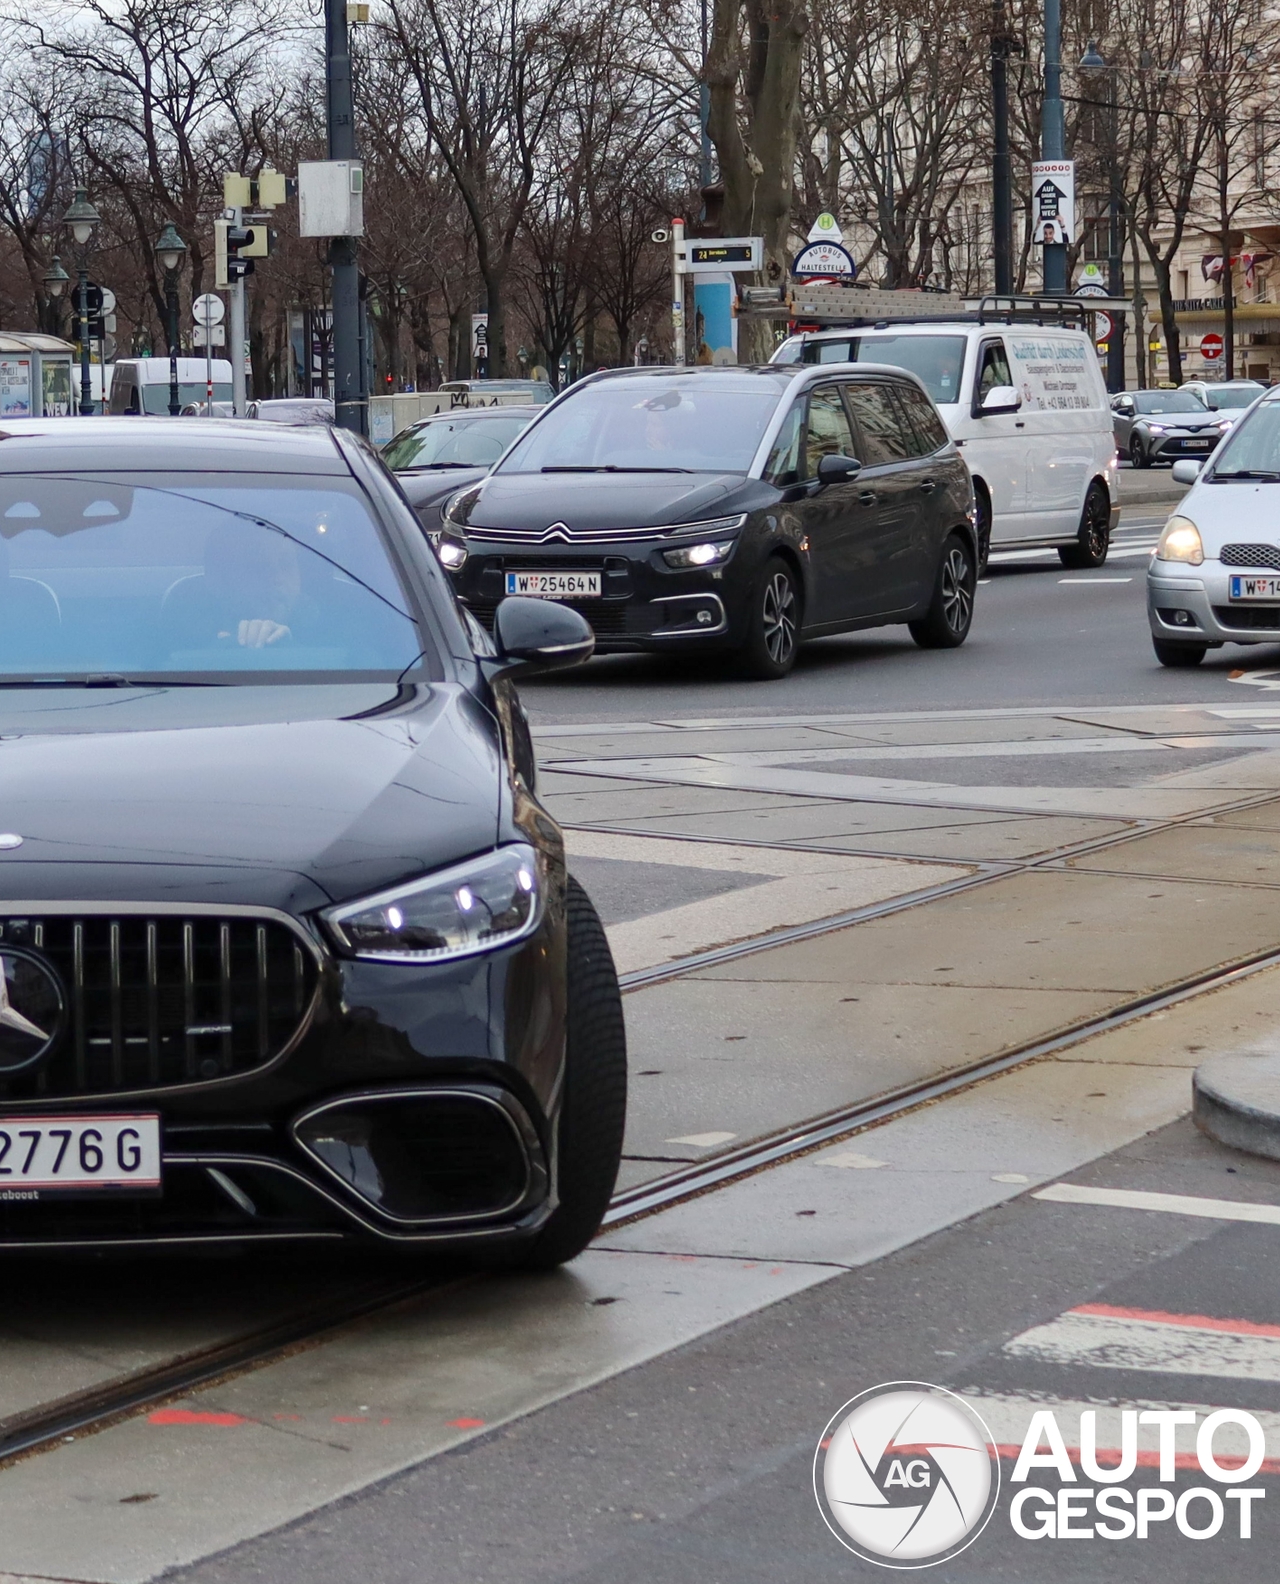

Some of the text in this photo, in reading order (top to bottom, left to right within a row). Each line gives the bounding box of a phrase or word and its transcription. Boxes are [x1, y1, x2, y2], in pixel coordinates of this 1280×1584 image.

[1042, 185, 1055, 193] AUF
[822, 217, 830, 227] H
[745, 250, 751, 258] 5
[808, 246, 842, 259] AUTOBUS
[801, 264, 847, 272] HALTESTELLE
[1079, 287, 1104, 296] AUTOBUS
[519, 578, 528, 592] W
[540, 576, 585, 592] 25464
[588, 577, 597, 592] N
[1245, 580, 1256, 595] W
[116, 1128, 141, 1172] G
